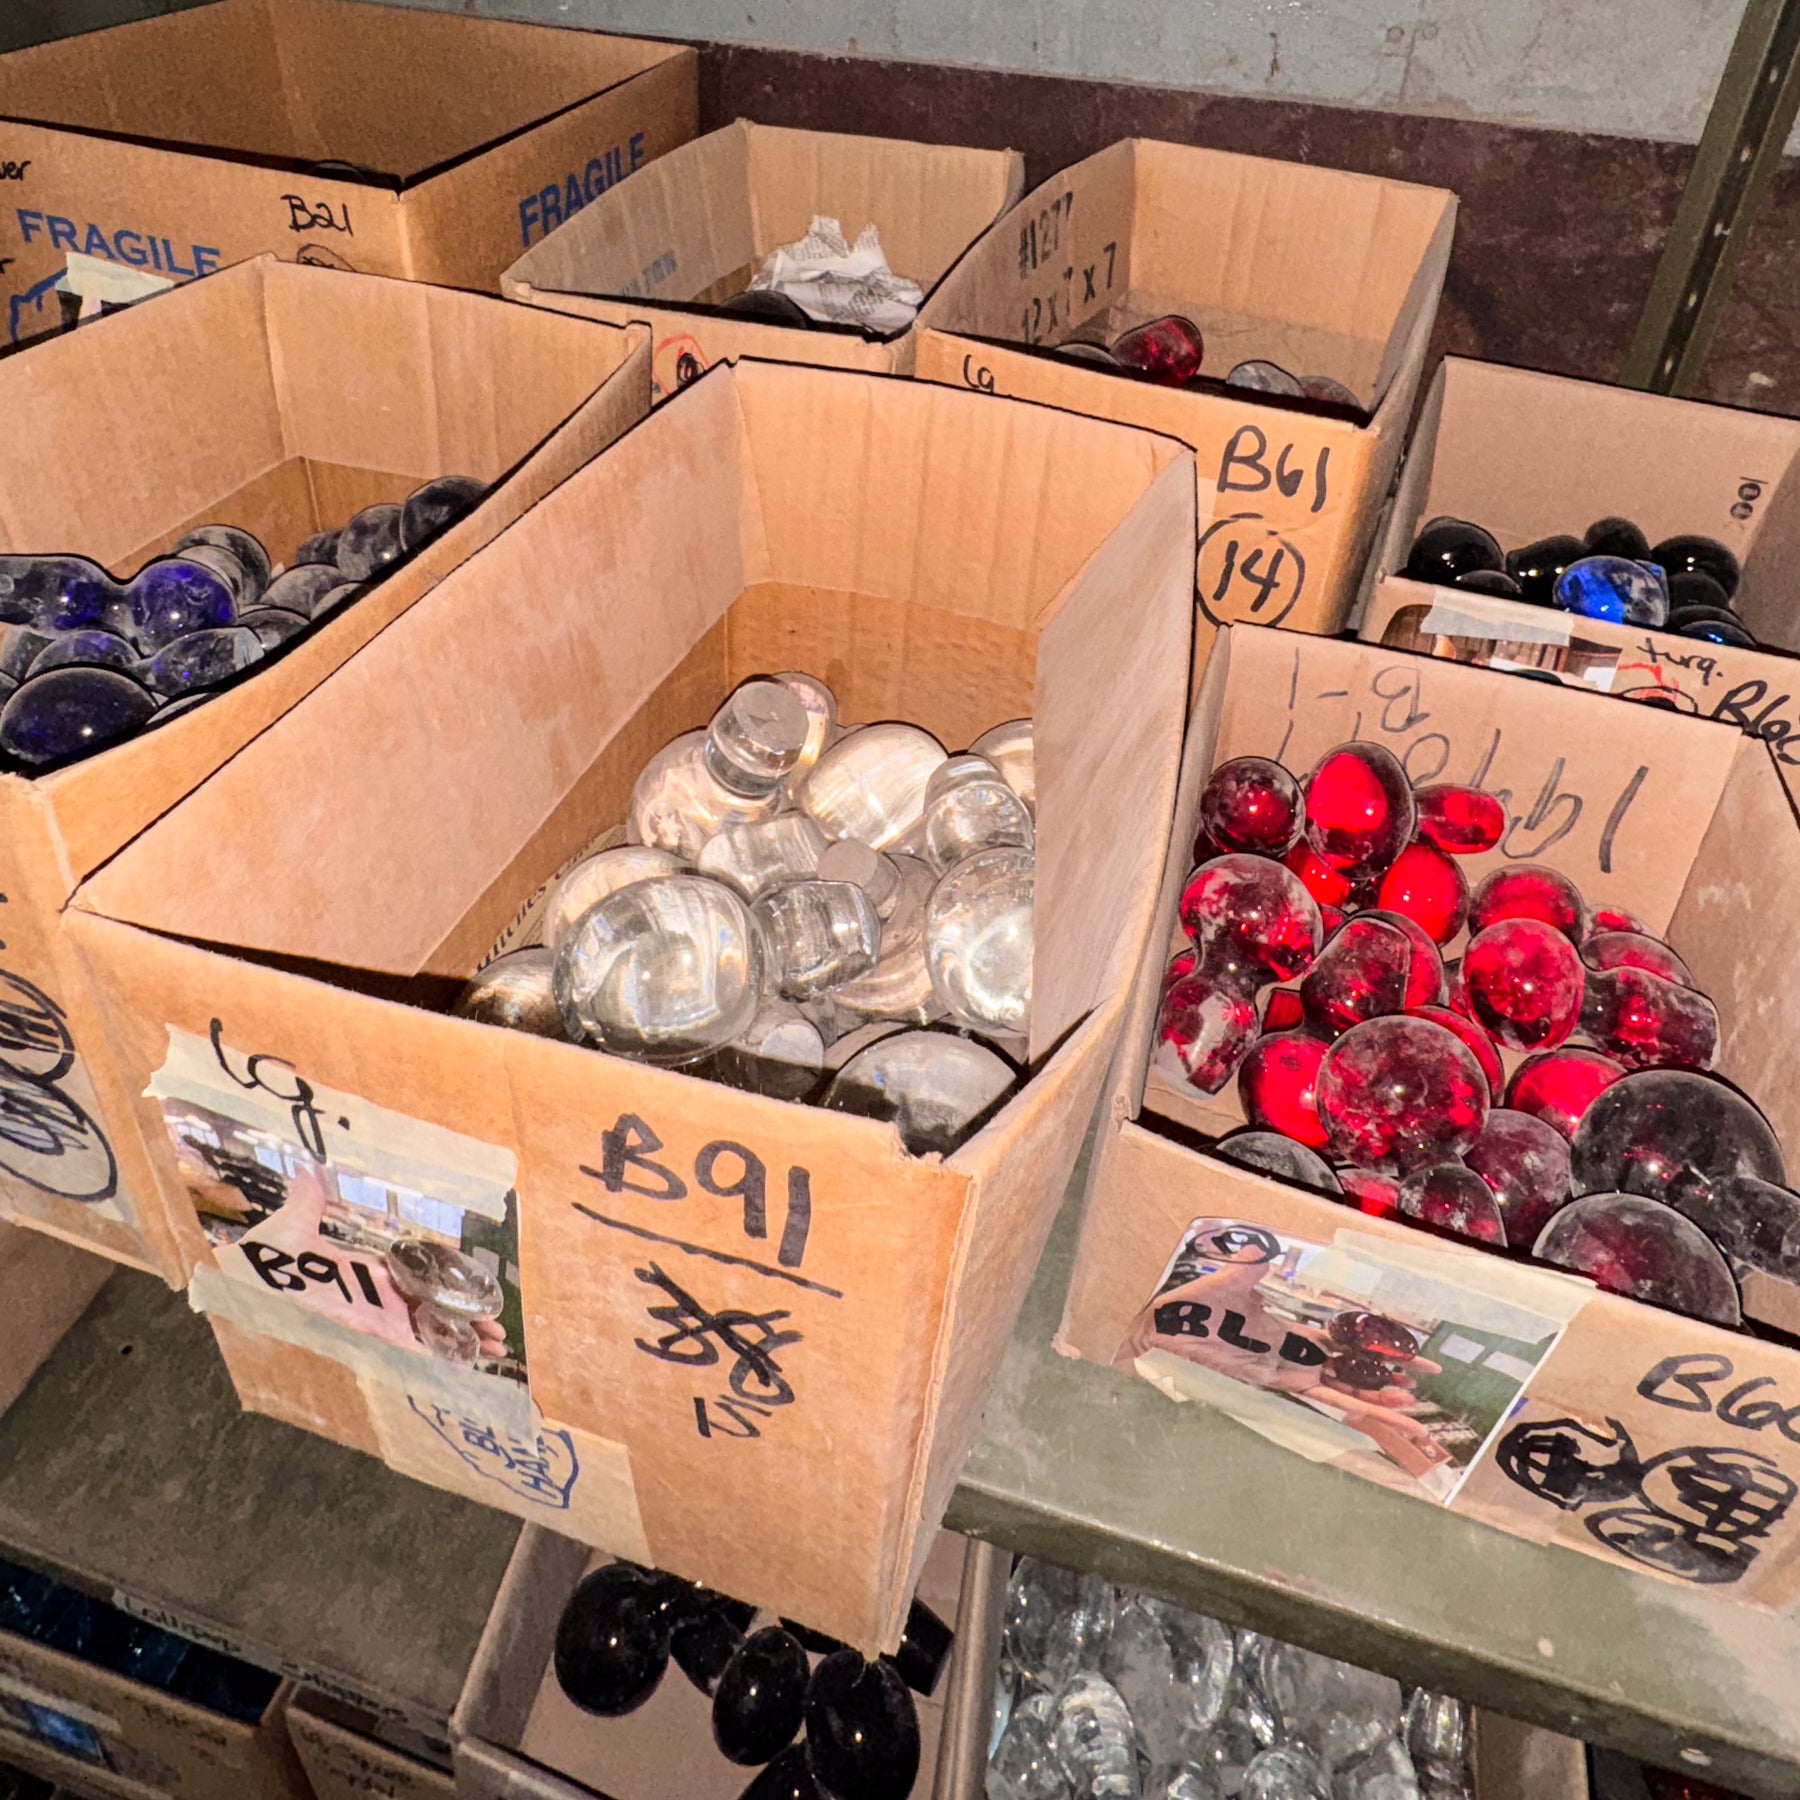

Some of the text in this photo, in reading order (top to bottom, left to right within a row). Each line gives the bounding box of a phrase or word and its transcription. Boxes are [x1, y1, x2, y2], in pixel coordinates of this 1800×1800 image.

[1216, 424, 1331, 513] B61
[1212, 540, 1285, 613] 14
[578, 1112, 812, 1269] B91
[238, 1241, 384, 1309] B91
